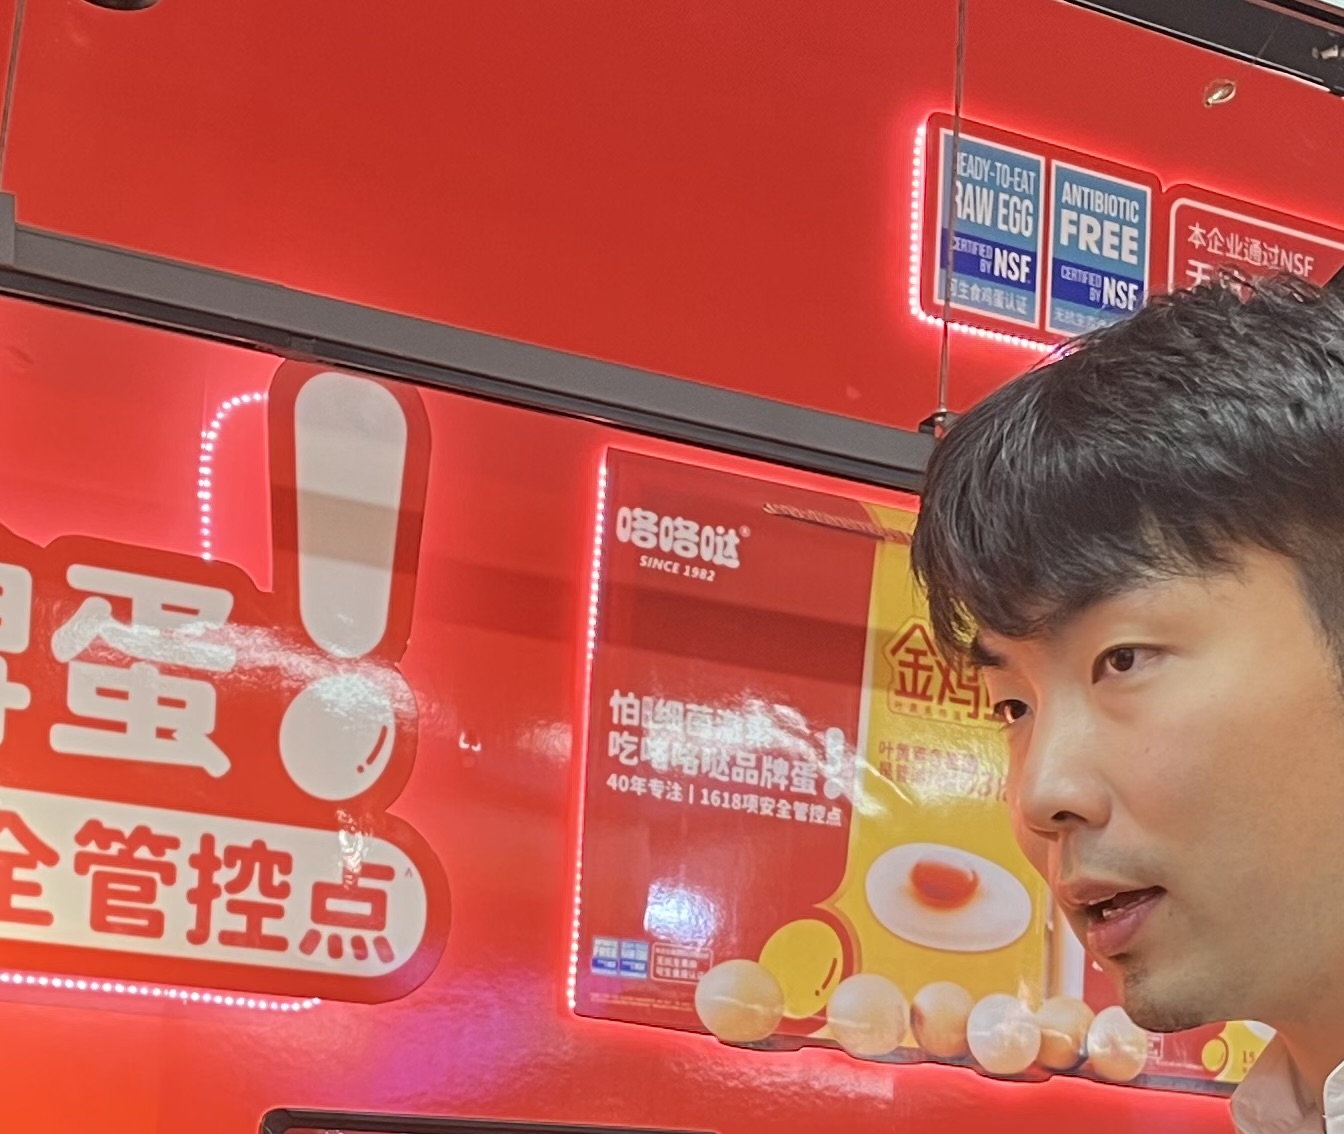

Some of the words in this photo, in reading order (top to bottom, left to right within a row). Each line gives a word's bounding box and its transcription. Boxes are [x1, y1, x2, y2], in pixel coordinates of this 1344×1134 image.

[997, 191, 1034, 239] EGG
[1061, 181, 1140, 224] ANTIBIOTIC
[1059, 209, 1140, 265] FREE
[1186, 222, 1316, 278] 本企业通过NSF
[993, 247, 1032, 284] NSF
[1060, 264, 1102, 288] CERTIFIED
[1089, 287, 1101, 301] BY
[1103, 277, 1140, 312] NSF
[639, 554, 680, 575] SINCE
[682, 564, 716, 583] 1982
[607, 773, 684, 803] 40年专注
